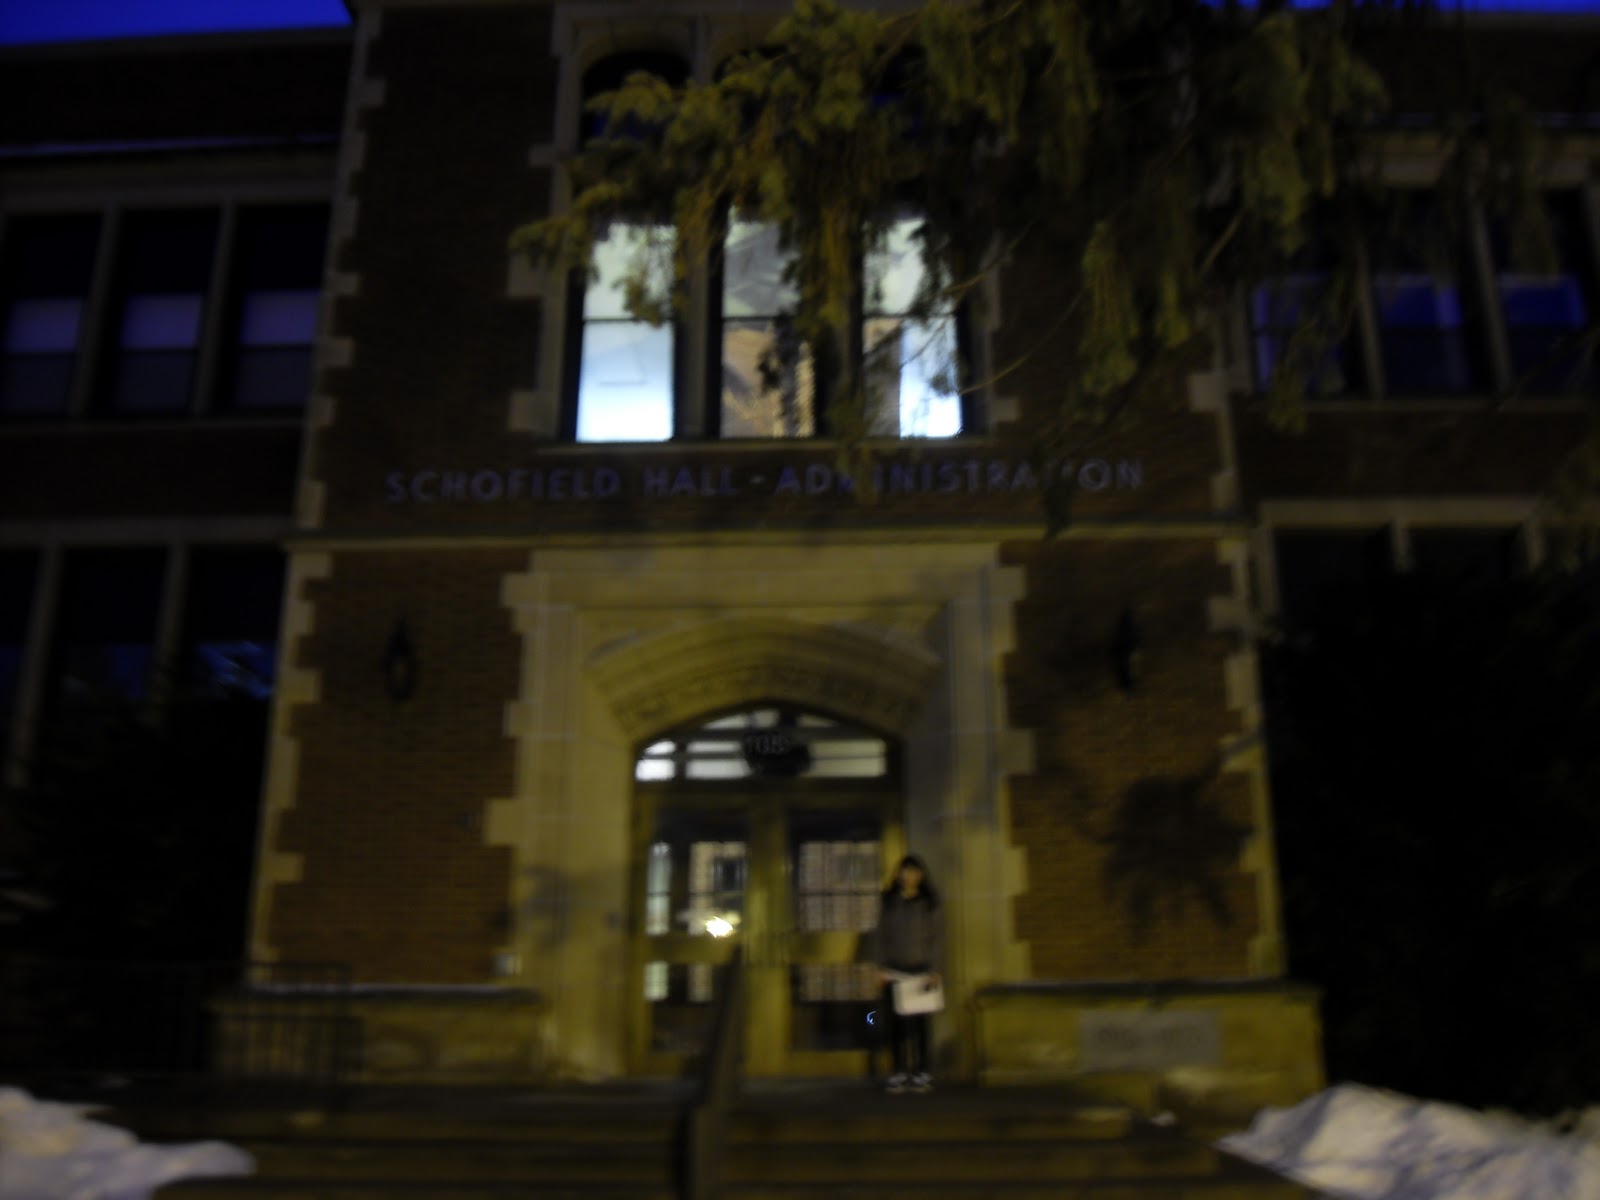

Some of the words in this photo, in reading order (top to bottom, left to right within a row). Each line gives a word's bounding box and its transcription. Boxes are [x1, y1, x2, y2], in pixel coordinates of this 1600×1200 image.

[383, 467, 621, 503] SCHOFIELD
[642, 464, 740, 498] HALL
[775, 459, 1143, 495] ADINISTRAION
